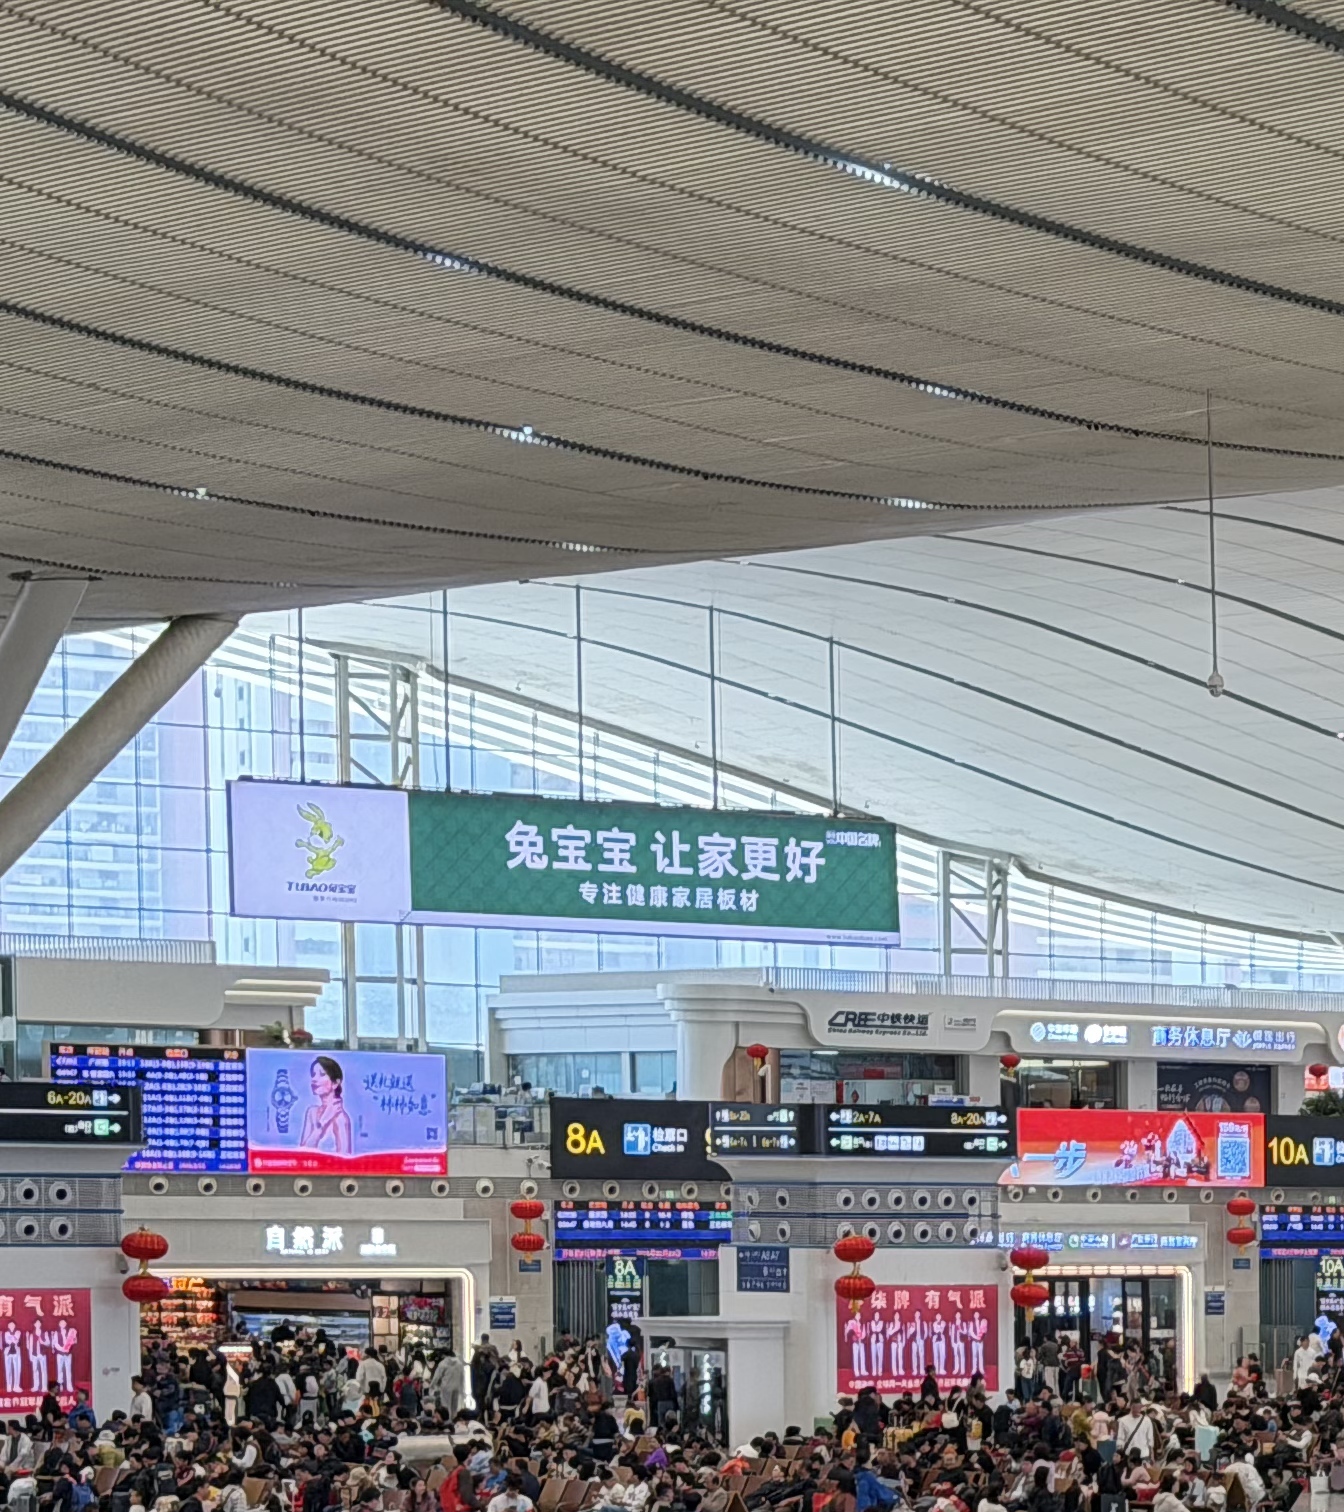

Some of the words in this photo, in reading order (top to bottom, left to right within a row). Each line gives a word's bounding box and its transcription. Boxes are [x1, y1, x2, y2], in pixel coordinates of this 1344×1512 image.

[506, 820, 637, 873] 兔宝宝
[650, 827, 826, 883] 让家更好
[578, 880, 760, 912] 专注健康家居板材
[566, 1122, 606, 1155] 8A
[1267, 1136, 1309, 1166] 10A
[266, 1225, 343, 1250] 自然派
[614, 1261, 636, 1276] 8A
[925, 1289, 986, 1310] 有气派
